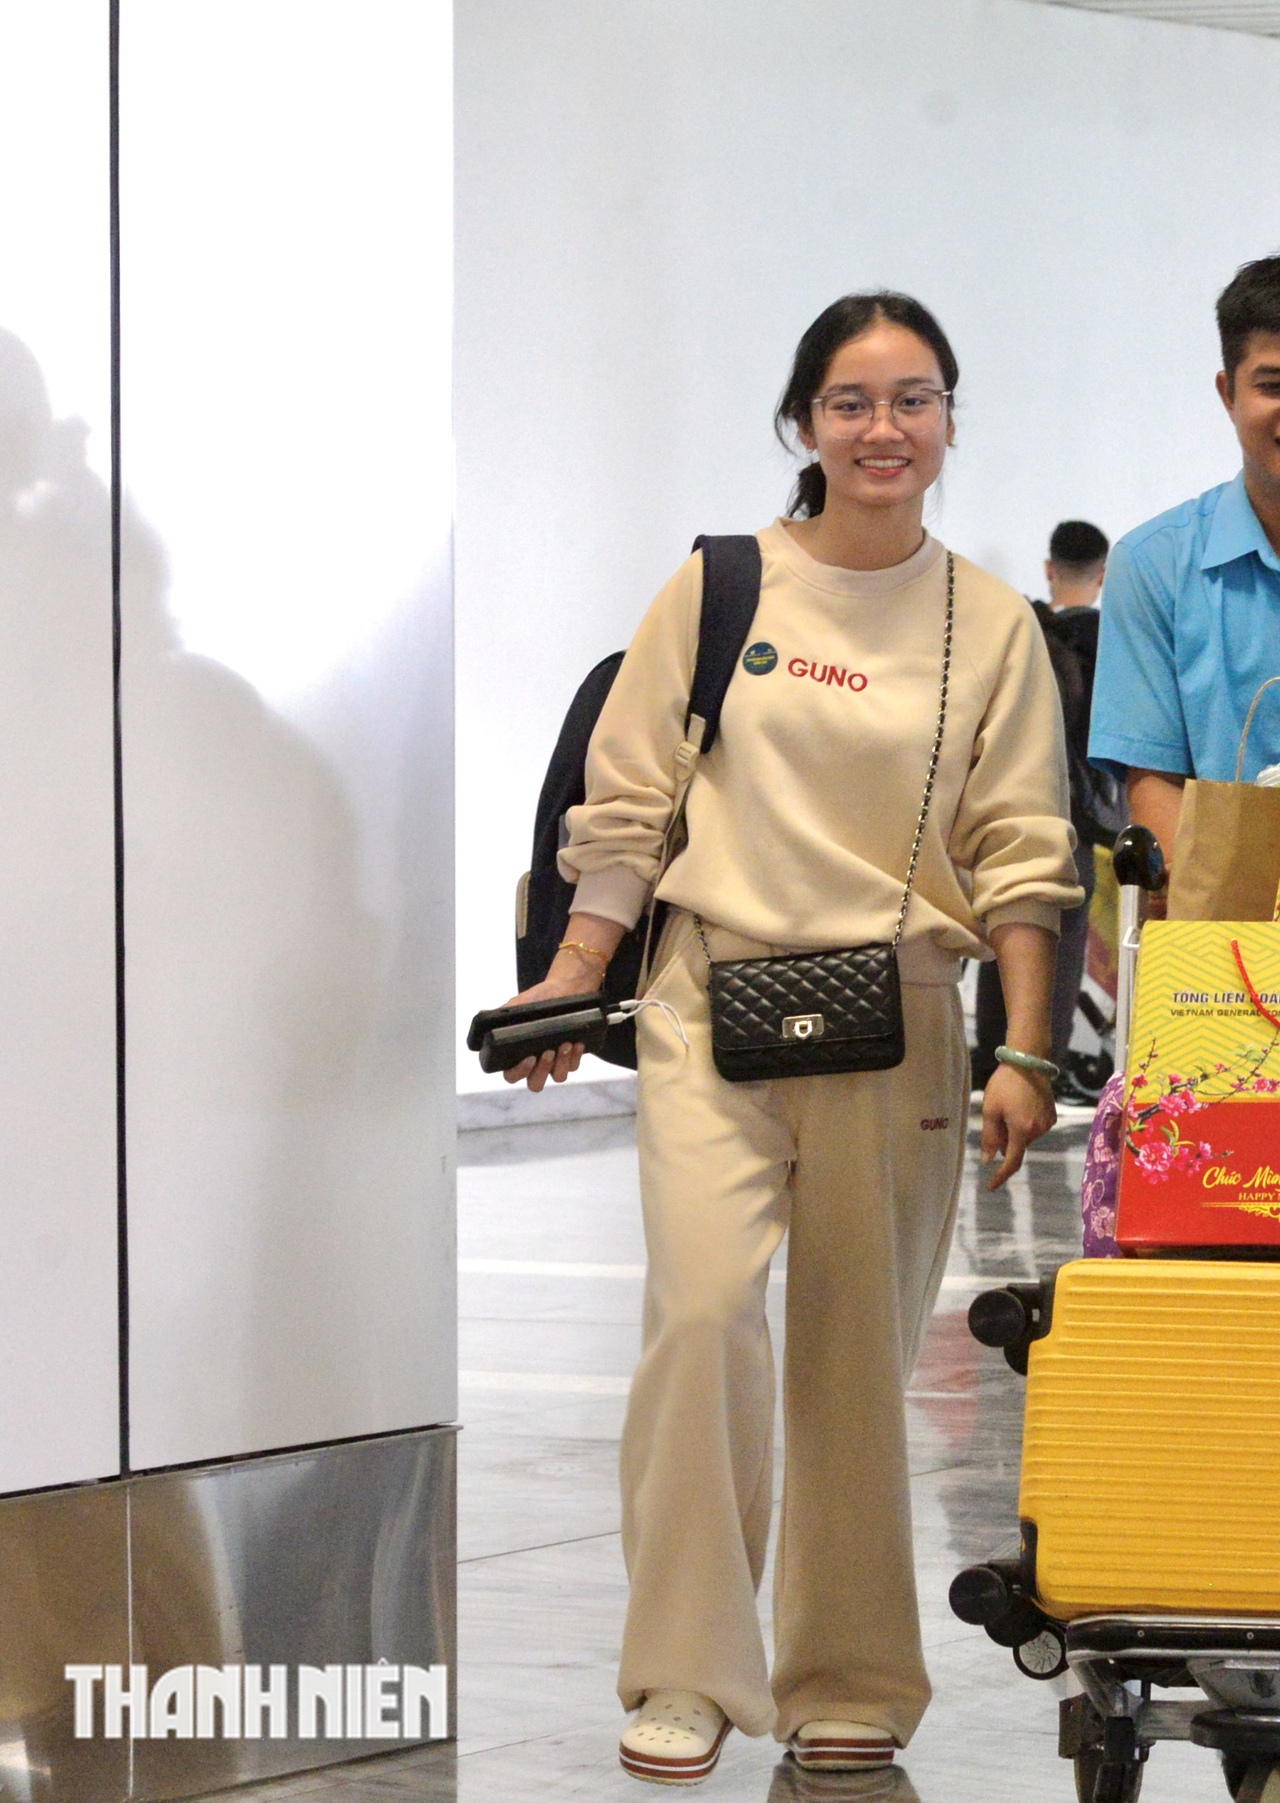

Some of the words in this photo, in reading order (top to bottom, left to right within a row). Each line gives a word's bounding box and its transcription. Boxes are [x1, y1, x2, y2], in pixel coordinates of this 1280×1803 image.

[788, 657, 868, 692] GUNO
[1171, 1009, 1214, 1017] VIETNAM
[1202, 1166, 1242, 1188] Chúc
[1238, 1192, 1275, 1201] HAPPY
